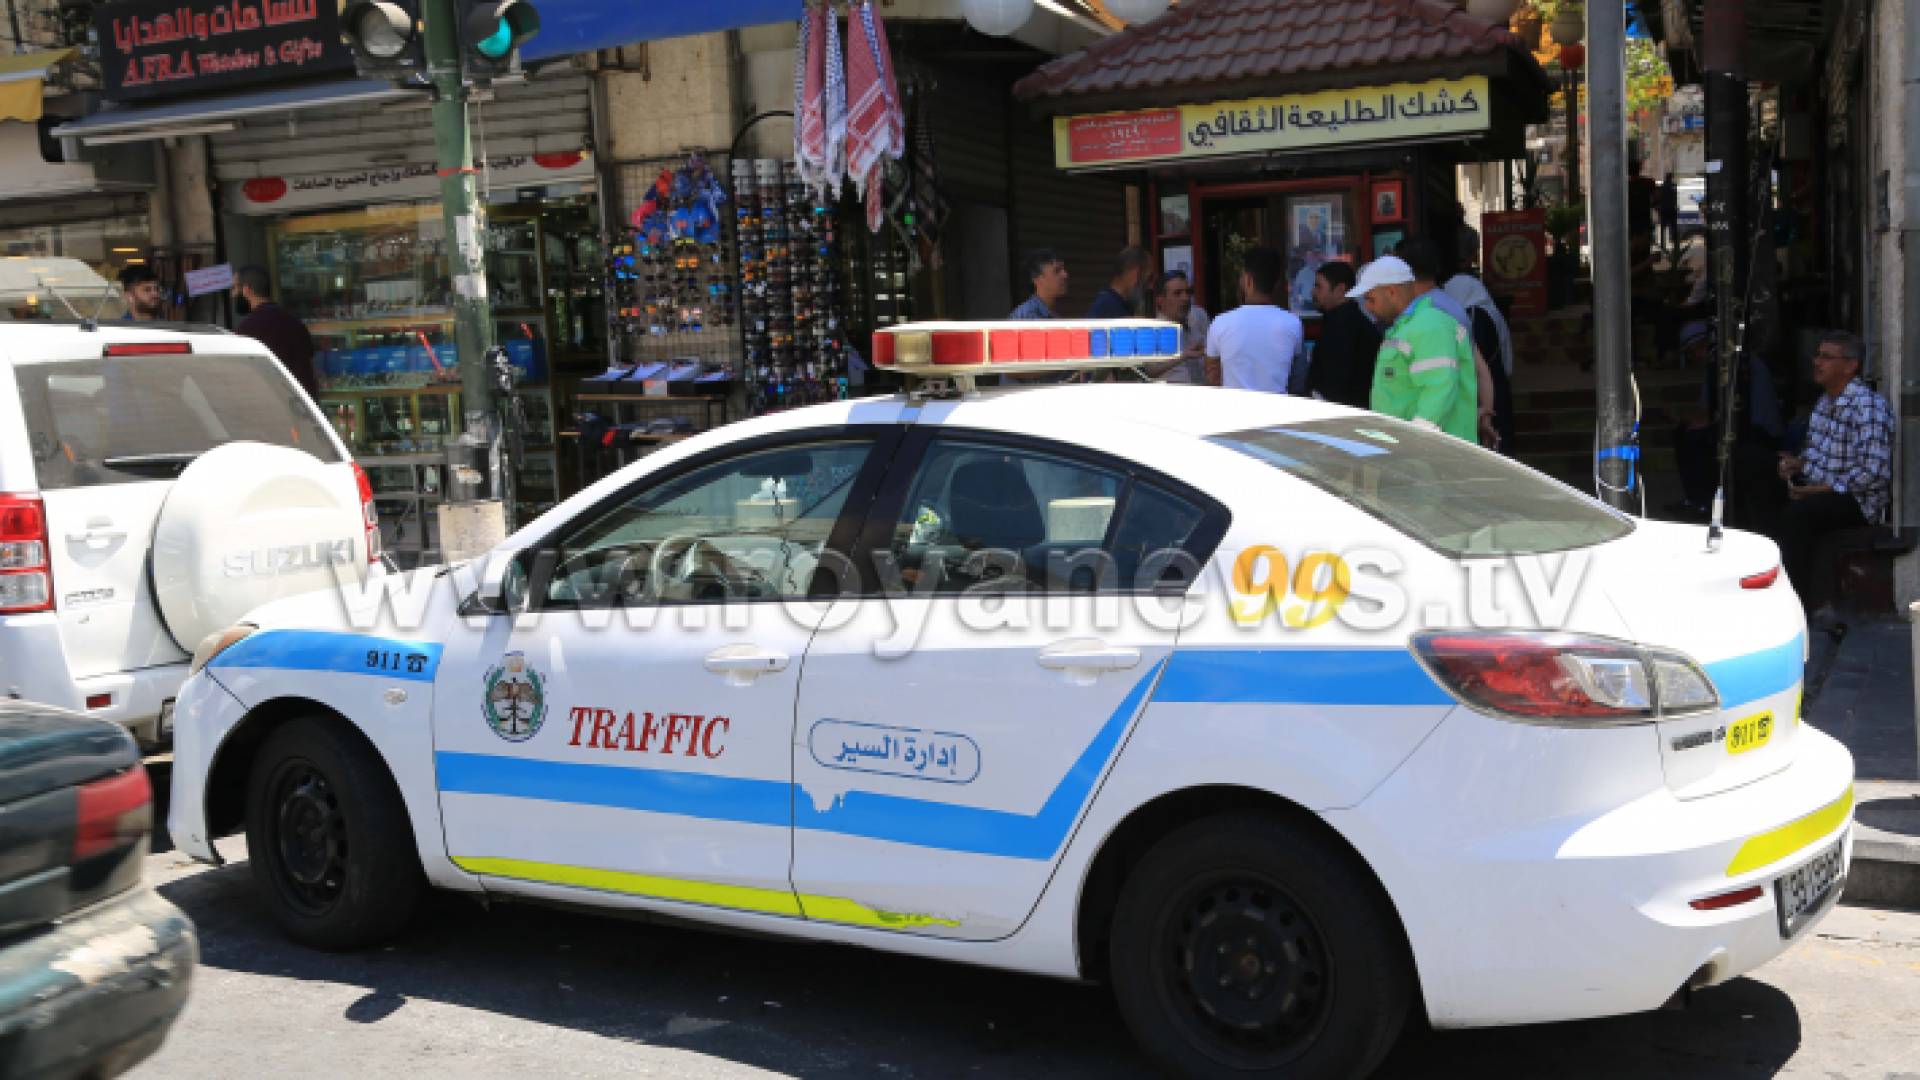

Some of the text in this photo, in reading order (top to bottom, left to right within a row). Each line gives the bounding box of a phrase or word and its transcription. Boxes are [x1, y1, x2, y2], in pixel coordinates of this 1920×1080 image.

[112, 7, 209, 55] والهدايا
[121, 50, 195, 88] AFRA
[1287, 93, 1395, 132] الطليعة
[1399, 87, 1479, 118] كشك
[1187, 104, 1284, 147] الثقافي
[224, 537, 355, 578] SUZUKI
[1227, 544, 1351, 629] 99
[365, 649, 401, 672] 911
[567, 705, 731, 759] TRAFFIC
[833, 734, 957, 777] إدارة السير
